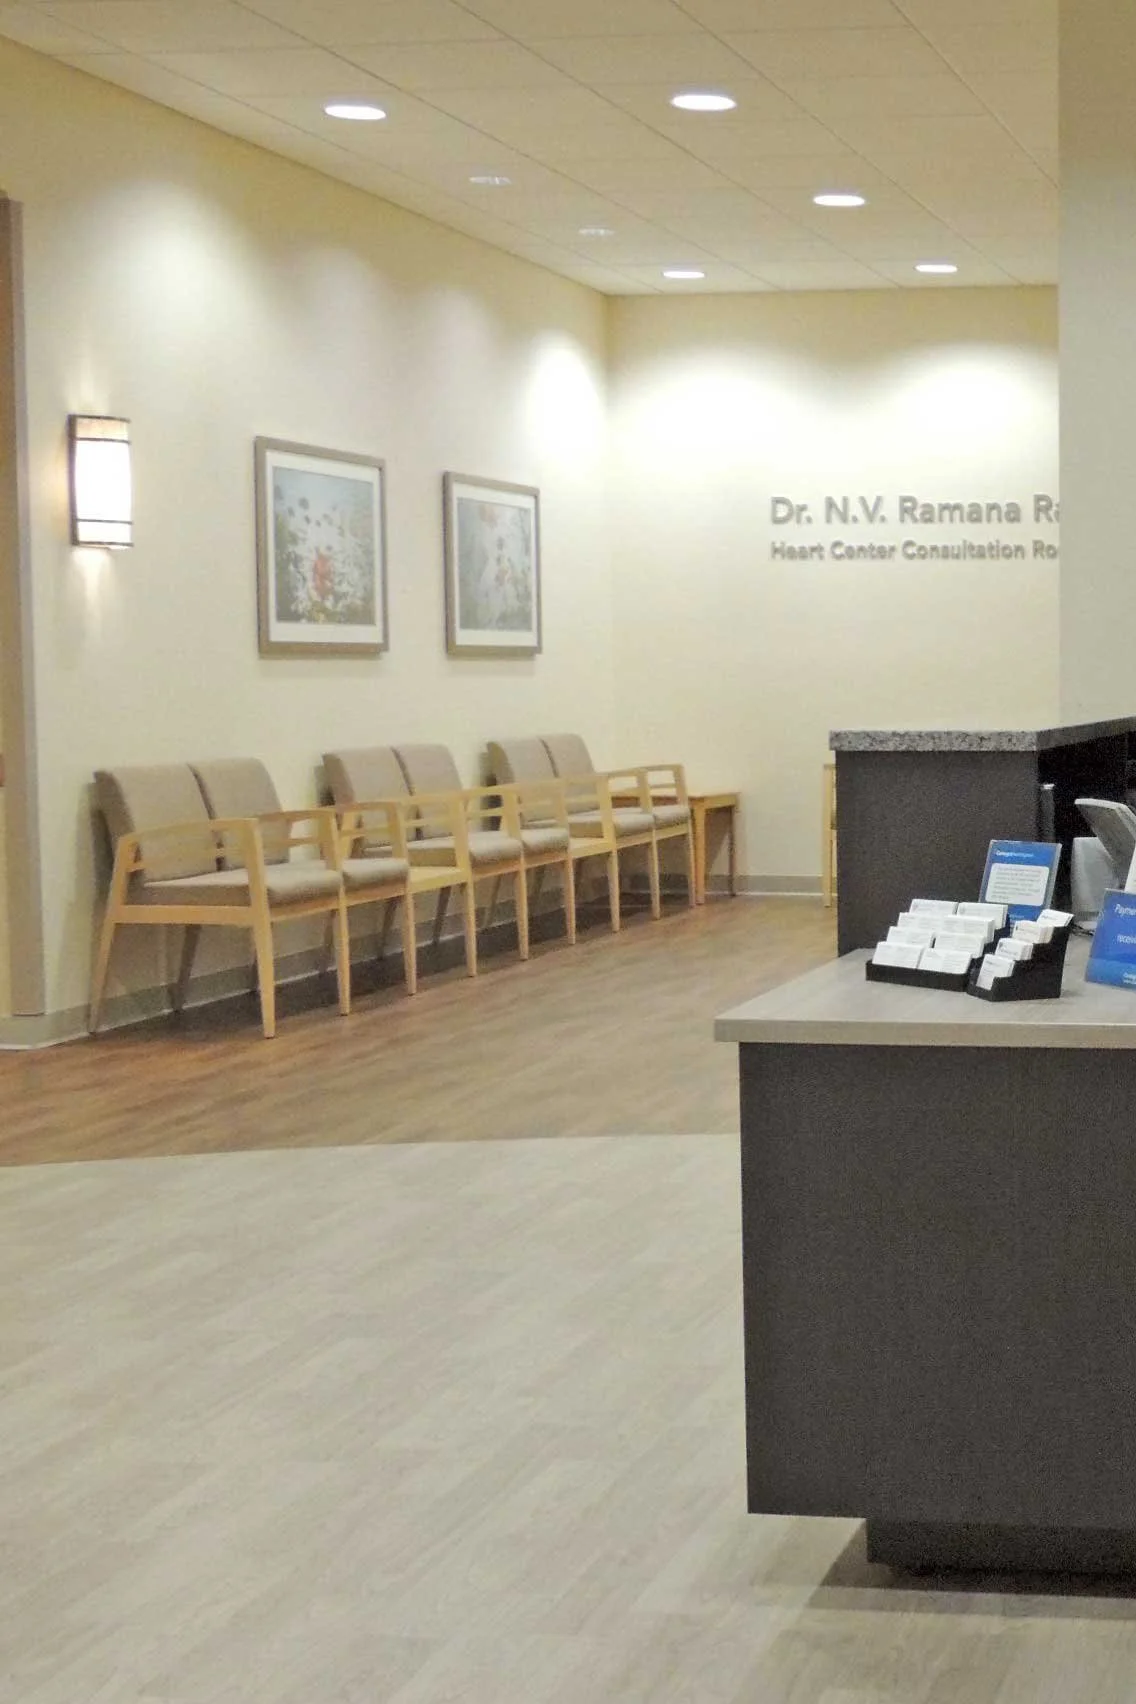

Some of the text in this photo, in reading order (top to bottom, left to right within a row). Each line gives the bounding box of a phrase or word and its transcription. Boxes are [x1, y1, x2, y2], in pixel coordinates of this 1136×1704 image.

[770, 494, 1059, 524] Dr. N.V. Ramana R
[770, 541, 825, 560] Heart
[830, 540, 897, 560] Center
[902, 539, 1026, 560] Consultation
